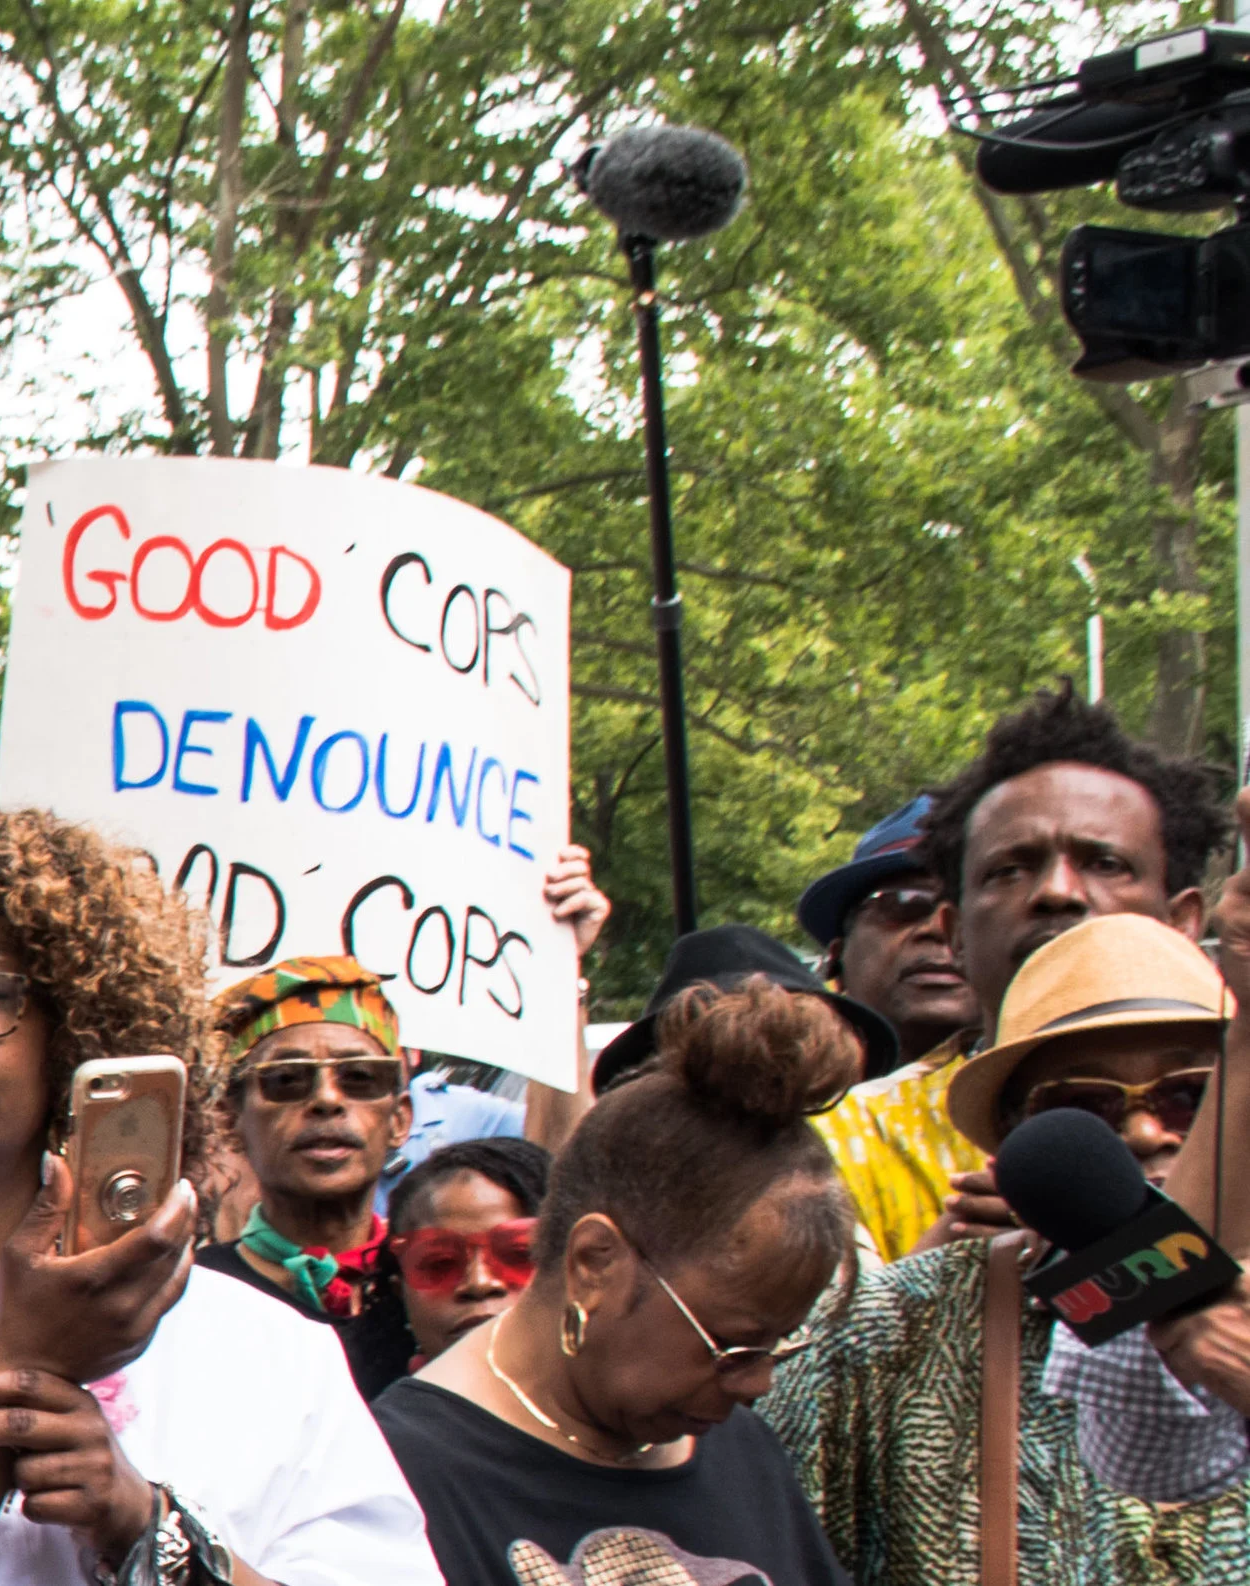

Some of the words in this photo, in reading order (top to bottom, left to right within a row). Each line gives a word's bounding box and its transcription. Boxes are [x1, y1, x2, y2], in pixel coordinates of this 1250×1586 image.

[380, 551, 541, 707] COPS
[111, 700, 541, 861] DENOUNCE
[342, 875, 534, 1020] COPS
